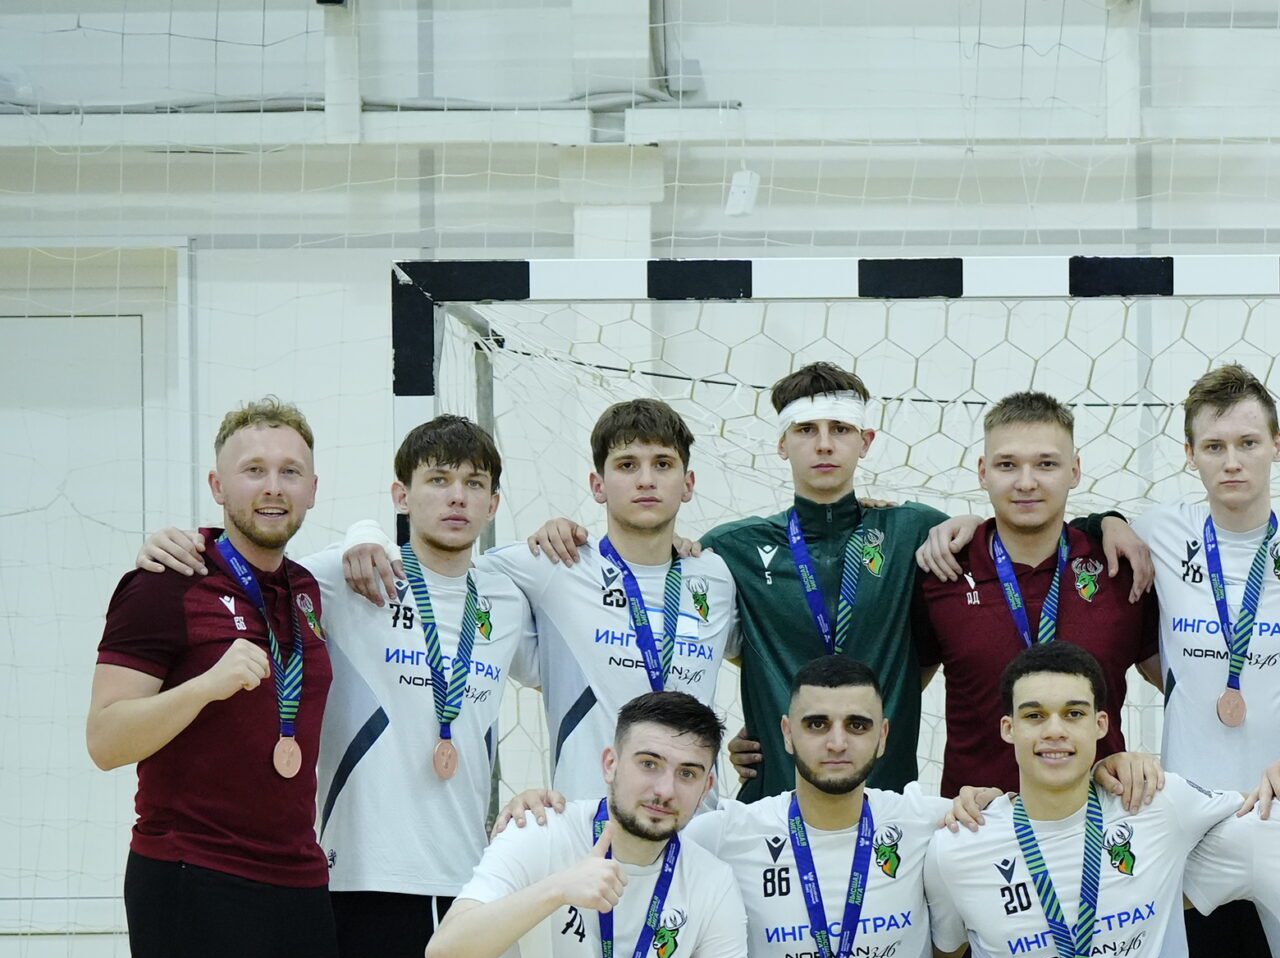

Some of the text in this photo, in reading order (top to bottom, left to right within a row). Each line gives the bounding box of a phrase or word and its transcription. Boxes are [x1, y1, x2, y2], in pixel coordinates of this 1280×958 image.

[765, 571, 772, 585] 5
[389, 604, 414, 629] 79
[595, 629, 714, 660] ИНГСТРАХ
[385, 648, 501, 682] ИНГСТРАХ
[763, 868, 790, 897] 86
[1000, 882, 1032, 915] 20
[561, 906, 586, 943] 74
[765, 911, 912, 943] ИНГСТРАХ
[1007, 901, 1156, 955] ИНГТРАХ
